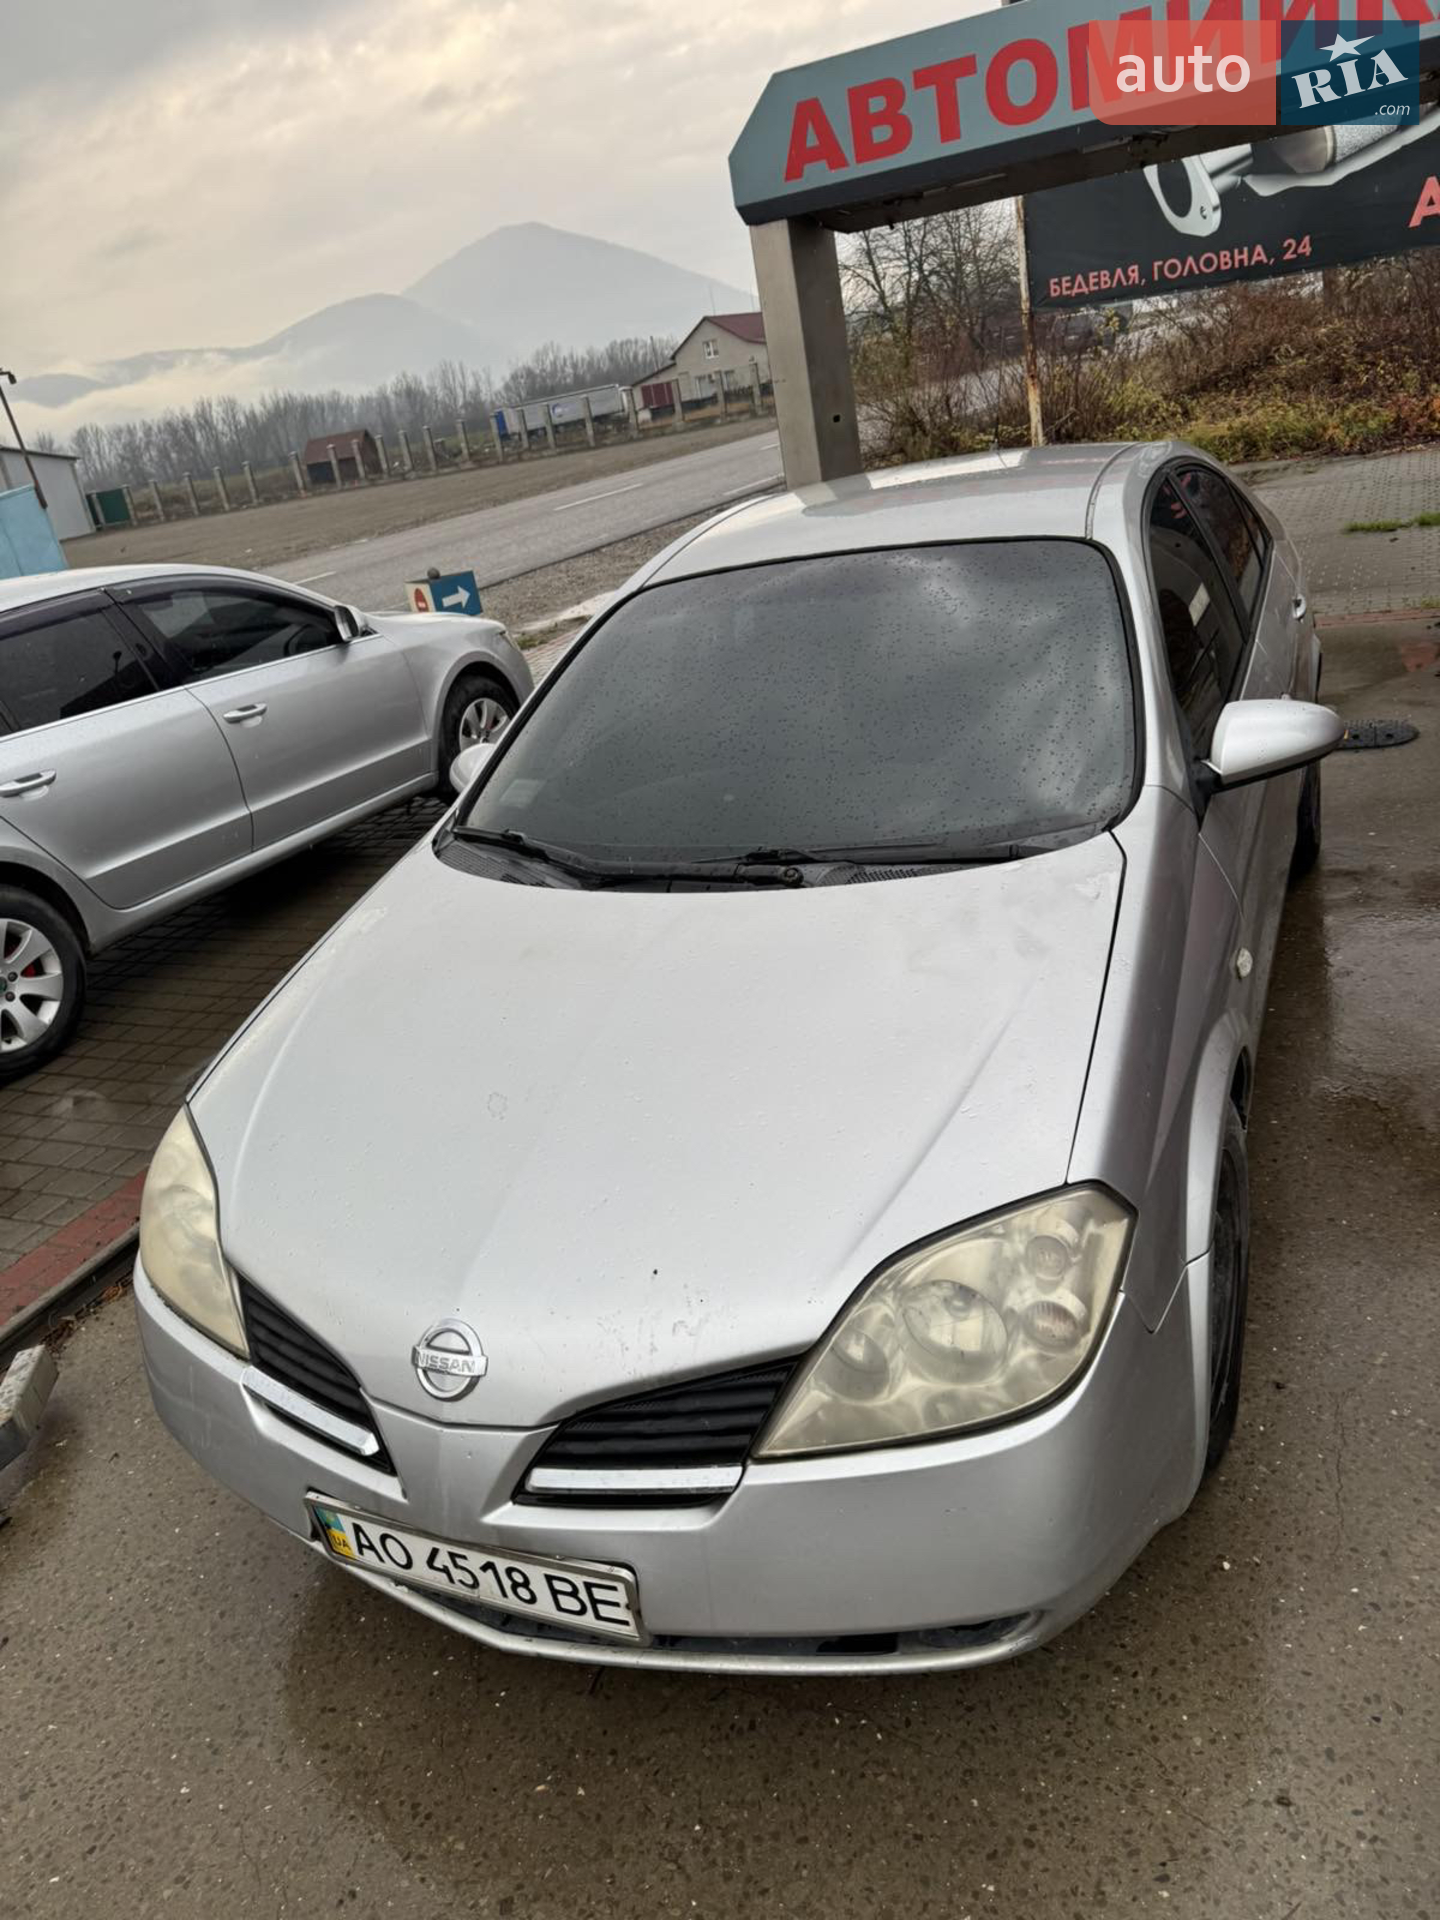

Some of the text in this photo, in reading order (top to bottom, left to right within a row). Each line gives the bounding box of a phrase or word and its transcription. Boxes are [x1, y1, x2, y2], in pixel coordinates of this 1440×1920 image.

[1049, 235, 1312, 298] БЕДЕВЛЯ, ГОЛОВНА, 24
[418, 1352, 476, 1373] NISSAN
[352, 1522, 631, 1627] AO 4518 BE
